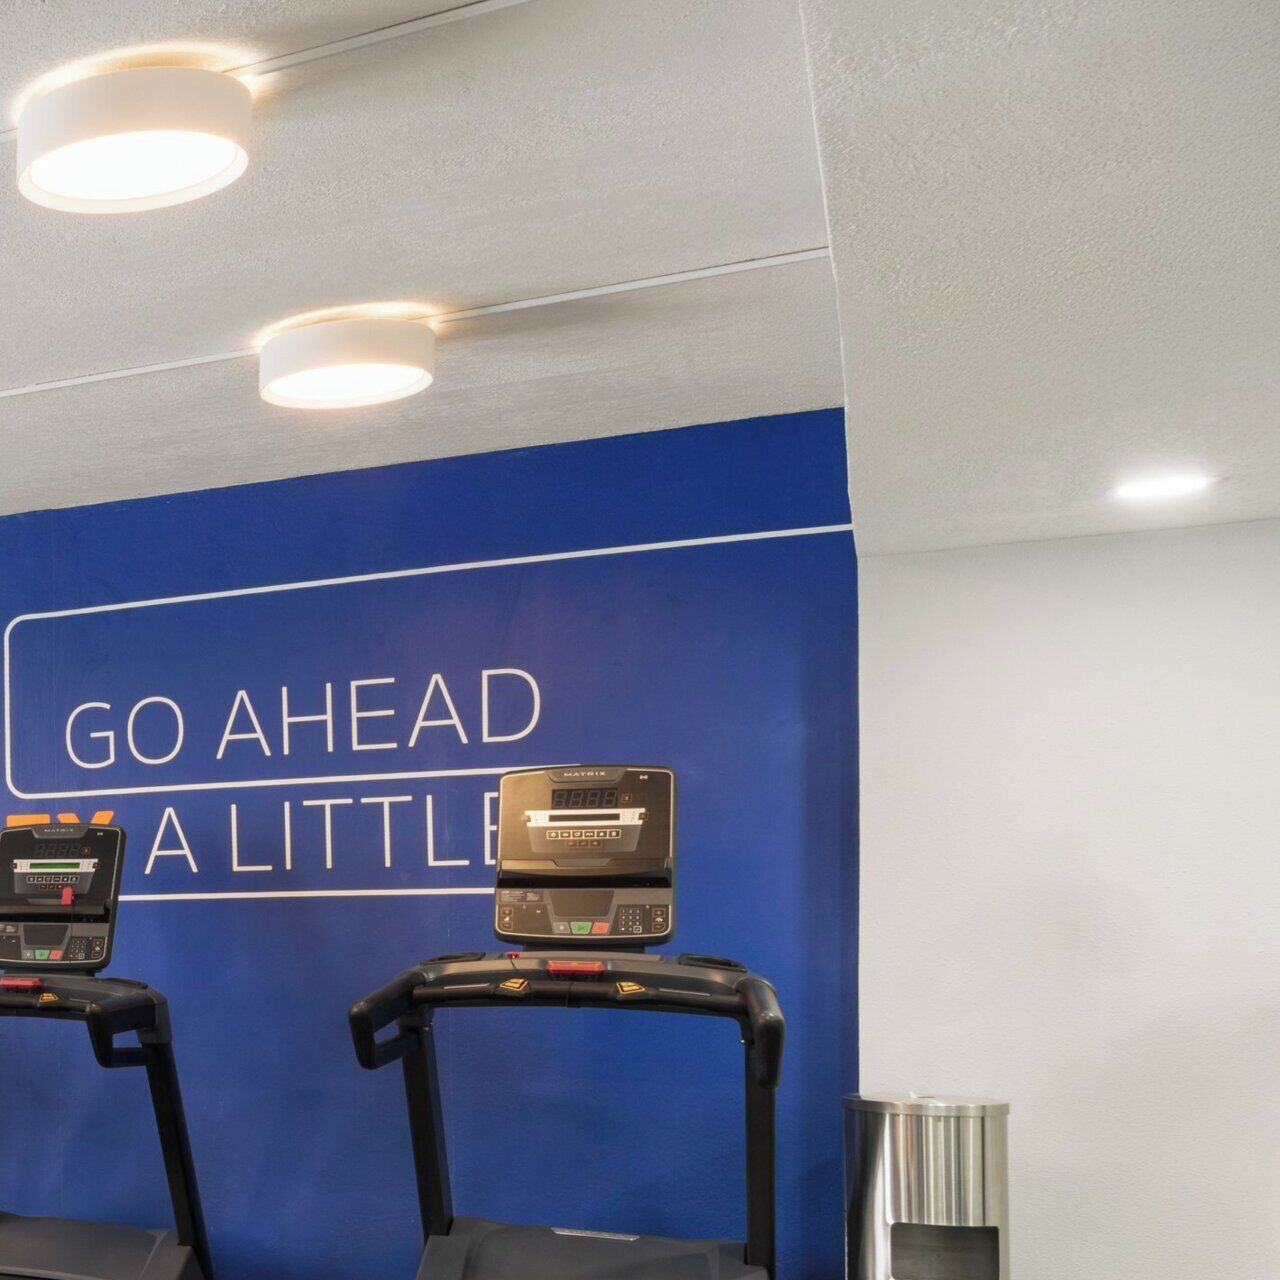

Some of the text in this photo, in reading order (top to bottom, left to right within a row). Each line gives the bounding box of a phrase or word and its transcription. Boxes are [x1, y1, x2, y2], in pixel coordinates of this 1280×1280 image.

[65, 668, 541, 769] GO AHEAD
[144, 806, 198, 874] A
